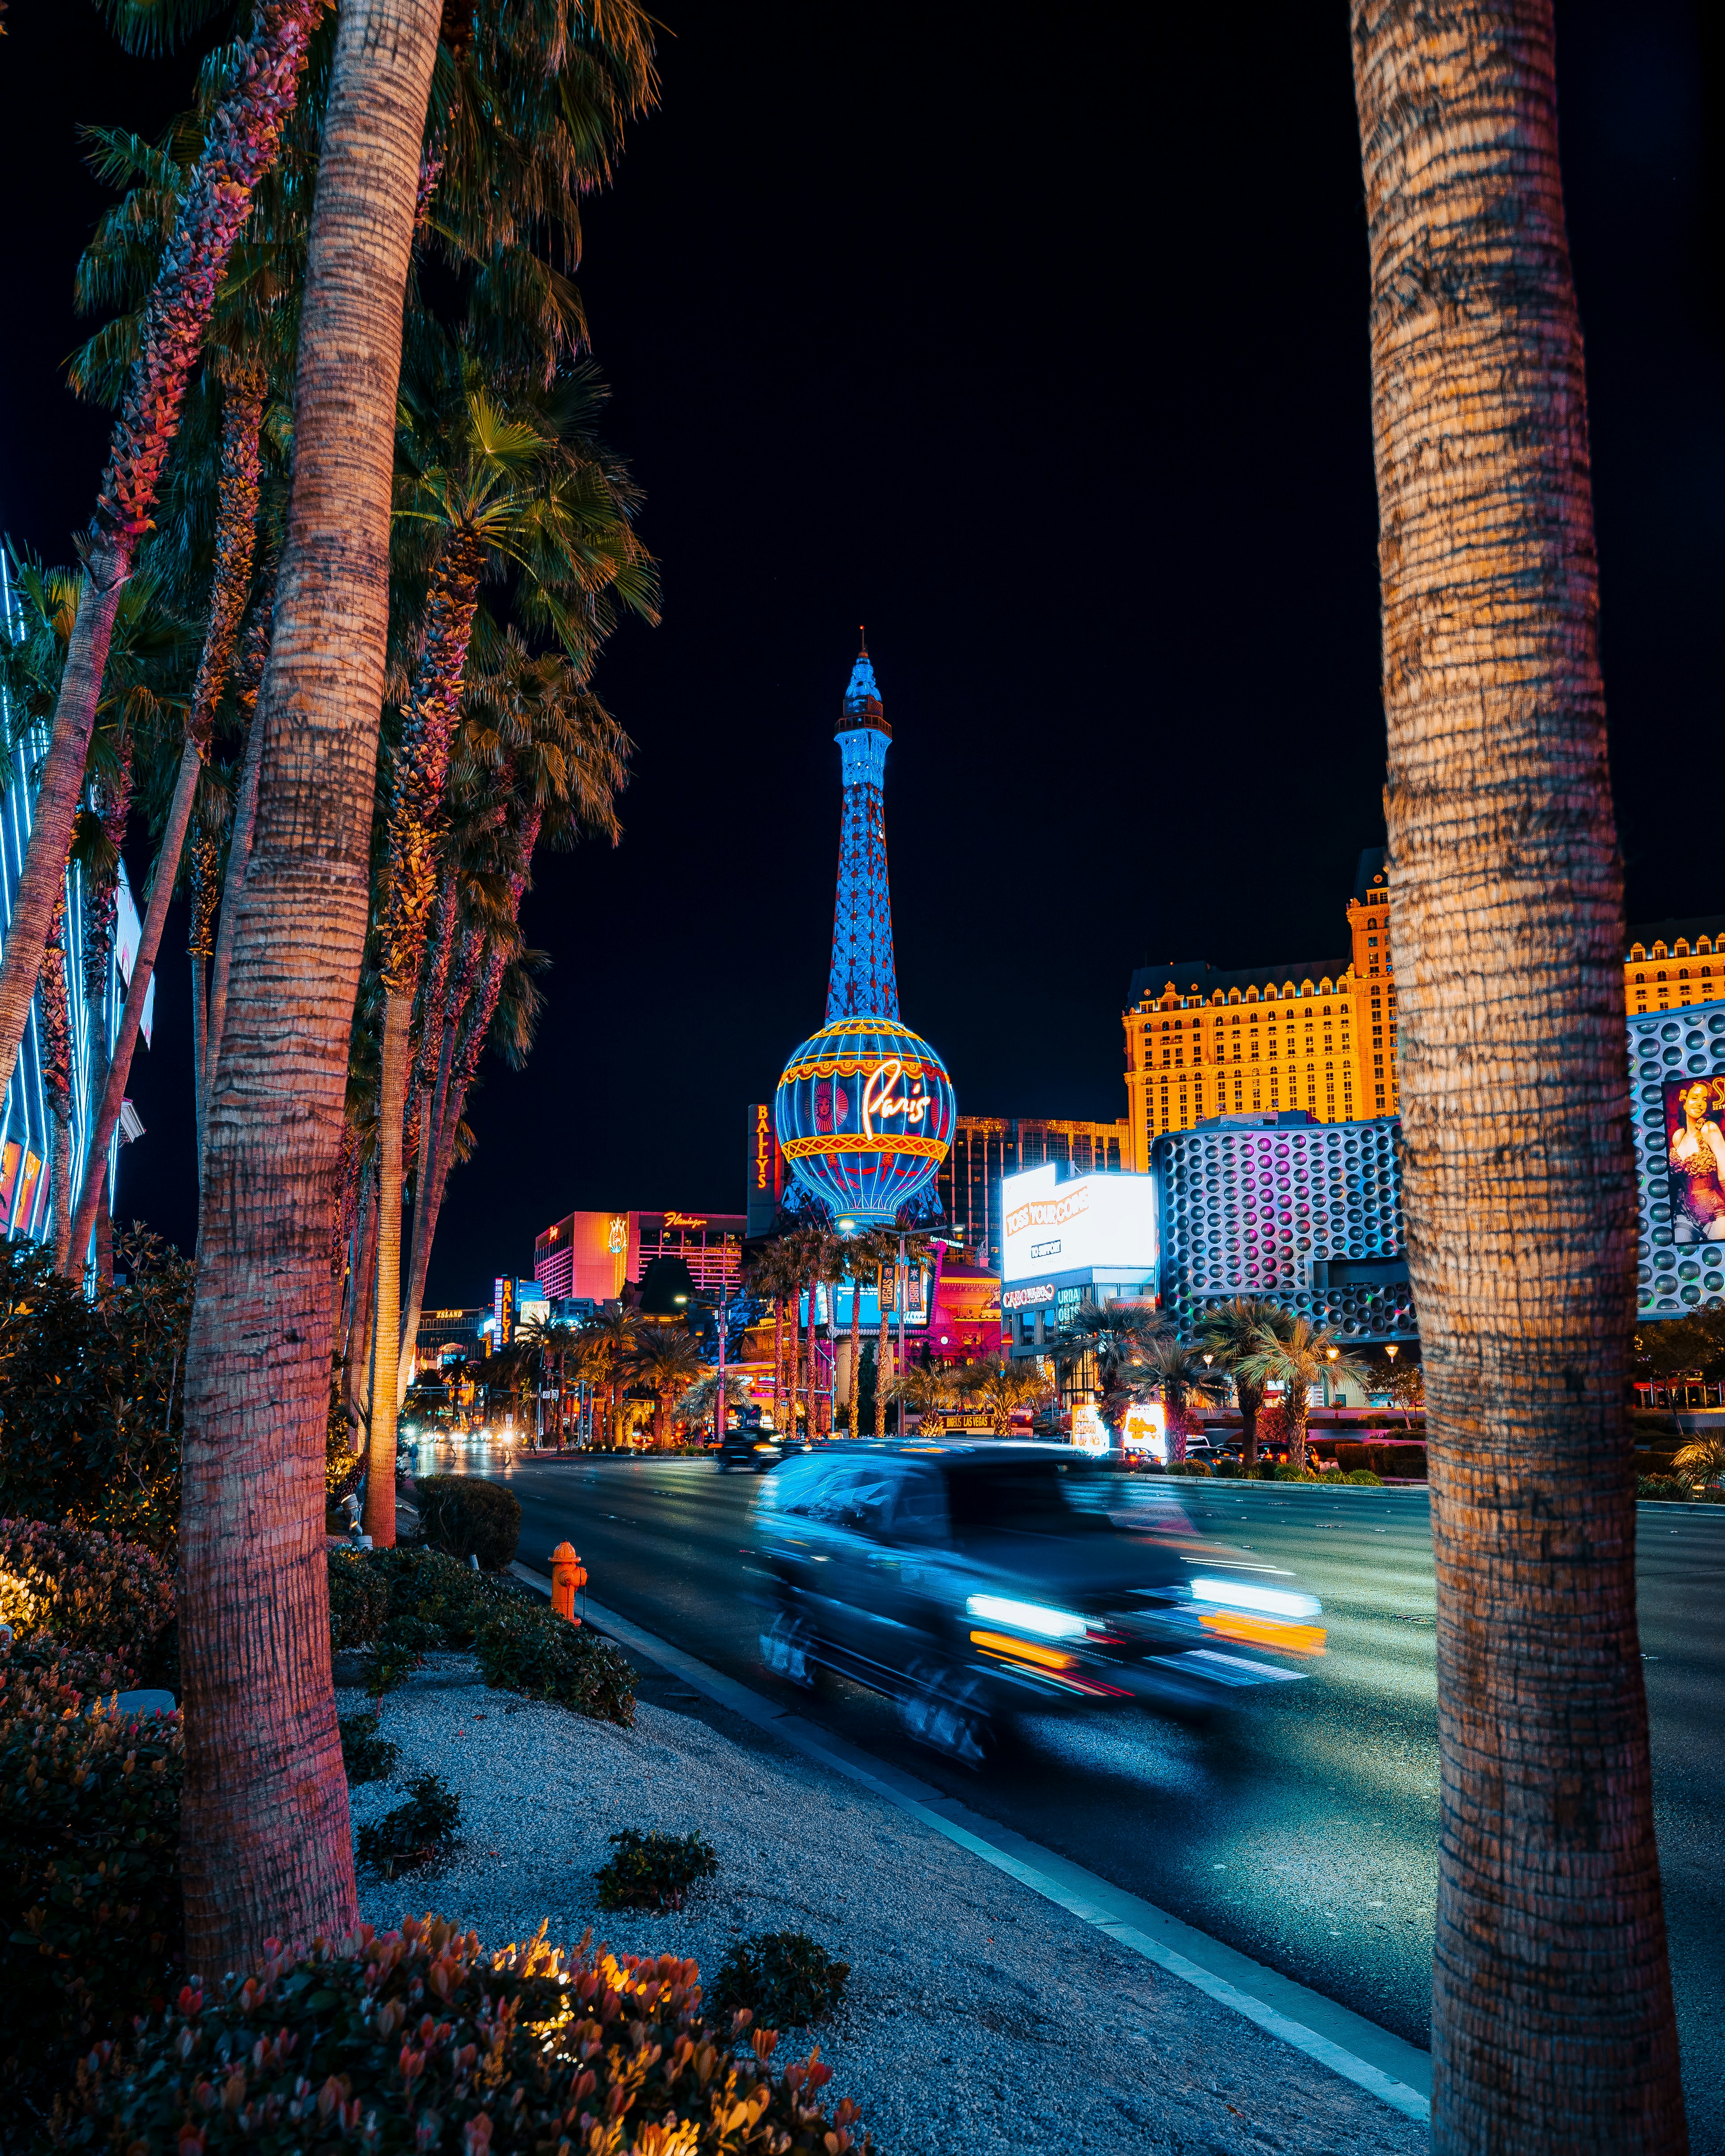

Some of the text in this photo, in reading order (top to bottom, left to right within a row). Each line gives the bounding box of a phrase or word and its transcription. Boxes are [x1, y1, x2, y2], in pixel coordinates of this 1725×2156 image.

[862, 1059, 931, 1141] Paris
[756, 1105, 769, 1188] BALLYS
[664, 1212, 707, 1229] Flamingo
[1007, 1206, 1029, 1235] TOSS
[1030, 1204, 1057, 1225] YOUR
[882, 1279, 894, 1304] VEGAS
[909, 1281, 919, 1303] BORN
[1002, 1284, 1055, 1309] CABO WABO
[436, 1310, 463, 1318] ISLAND
[501, 1280, 512, 1344] BALLYS
[963, 1417, 972, 1427] LAS
[973, 1416, 988, 1427] VEGAS
